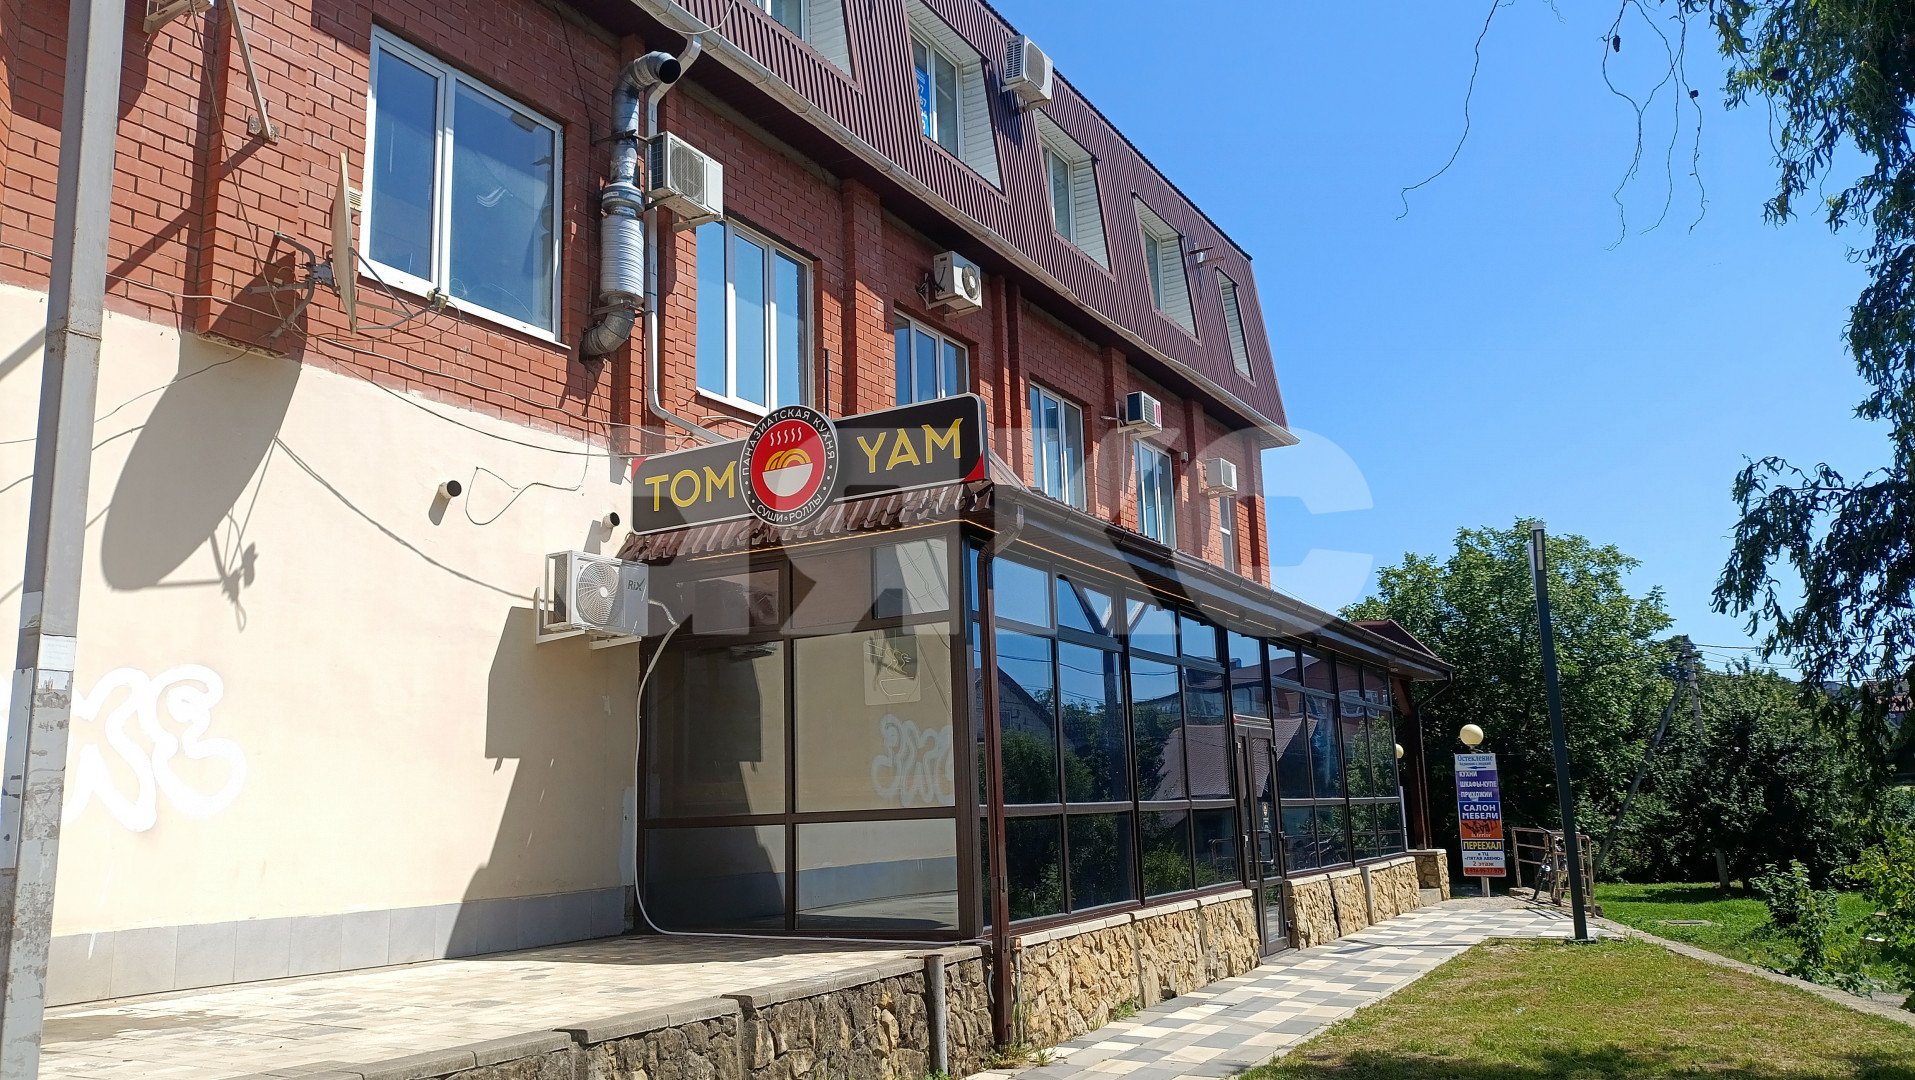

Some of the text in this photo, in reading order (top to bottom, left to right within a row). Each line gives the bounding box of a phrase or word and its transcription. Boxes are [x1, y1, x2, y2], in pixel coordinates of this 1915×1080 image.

[742, 408, 836, 476] ПАНАЗИАТСКАЯ КУХНЯ
[644, 417, 964, 512] TOM YAM
[756, 493, 823, 523] СУШИ РОЛЛЫ
[1460, 780, 1498, 788] ШКАФЫ-КУПЕ
[1462, 812, 1499, 820] МЕБЕЛИ
[1463, 841, 1502, 850] ПЕРЕЕХАЛ
